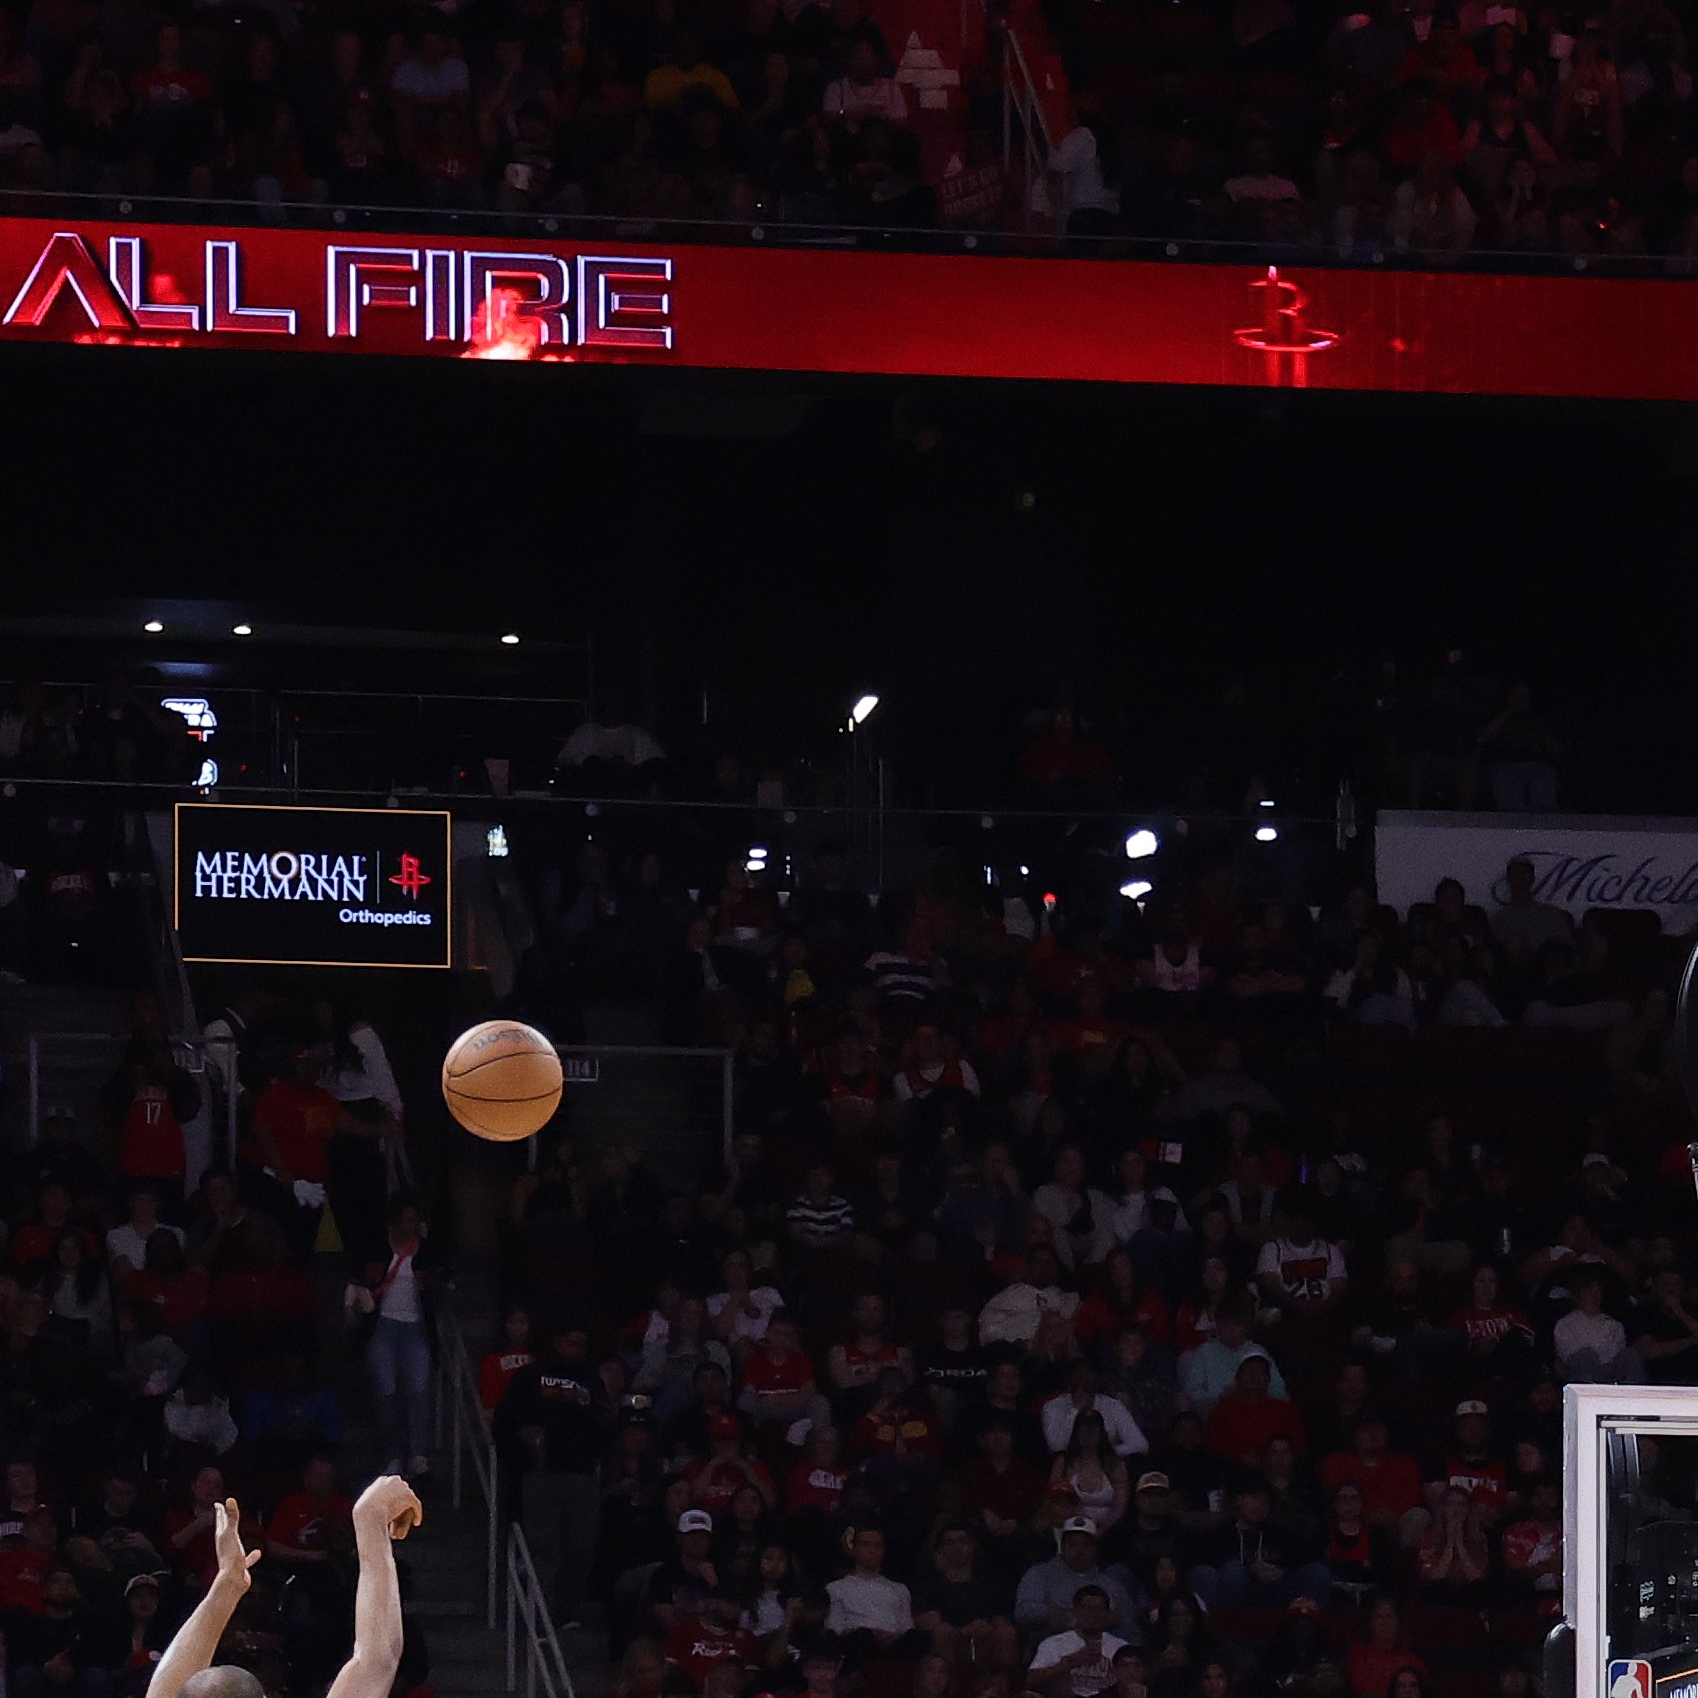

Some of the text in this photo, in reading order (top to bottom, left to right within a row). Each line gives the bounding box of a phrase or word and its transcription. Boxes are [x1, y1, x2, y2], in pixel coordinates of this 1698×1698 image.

[2, 232, 674, 352] ALL FIRE
[194, 850, 367, 880] MEMORIAL
[194, 872, 367, 902] HERMANN
[339, 908, 431, 927] Orthopedics
